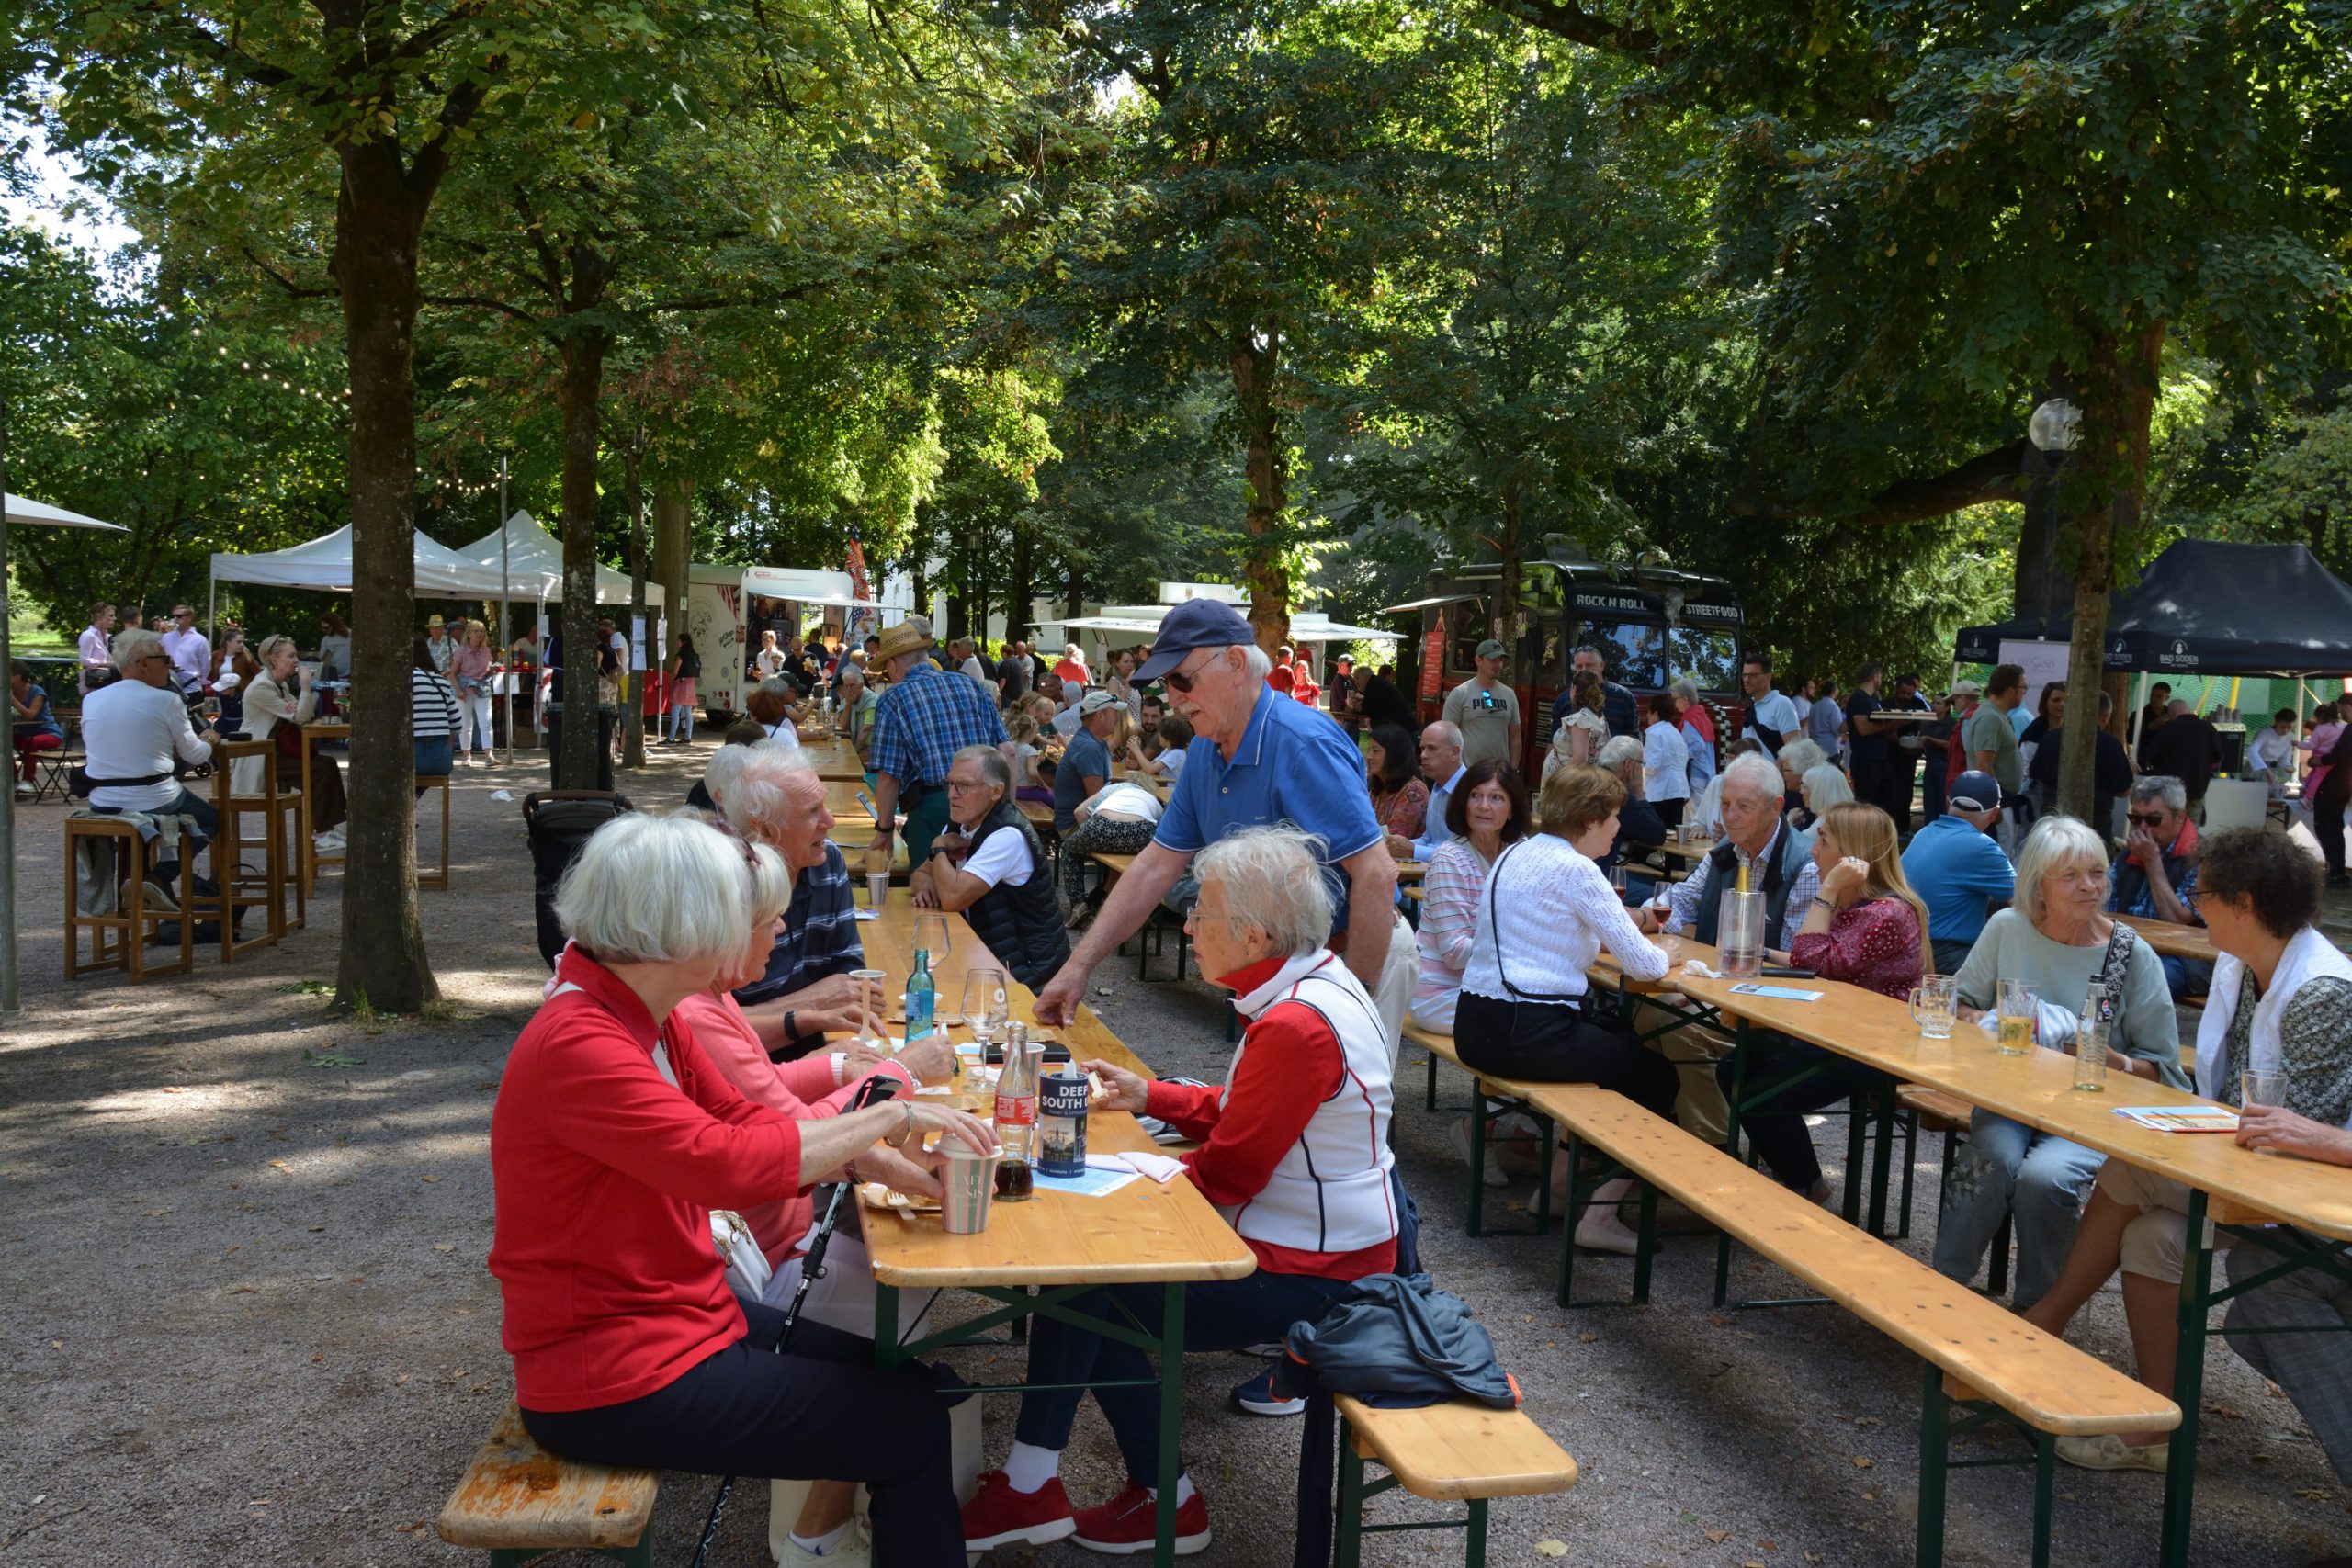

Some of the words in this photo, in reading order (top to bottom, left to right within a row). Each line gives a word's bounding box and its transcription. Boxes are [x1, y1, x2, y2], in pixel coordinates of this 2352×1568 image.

[1577, 594, 1606, 607] ROCK
[1608, 596, 1617, 608] N
[1619, 598, 1647, 611] ROLL
[1685, 604, 1739, 618] STREETFOOD
[2159, 653, 2174, 662] BAD
[2175, 654, 2199, 663] SODEN
[1059, 1085, 1088, 1097] DEEP
[1042, 1095, 1083, 1110] SOUTH
